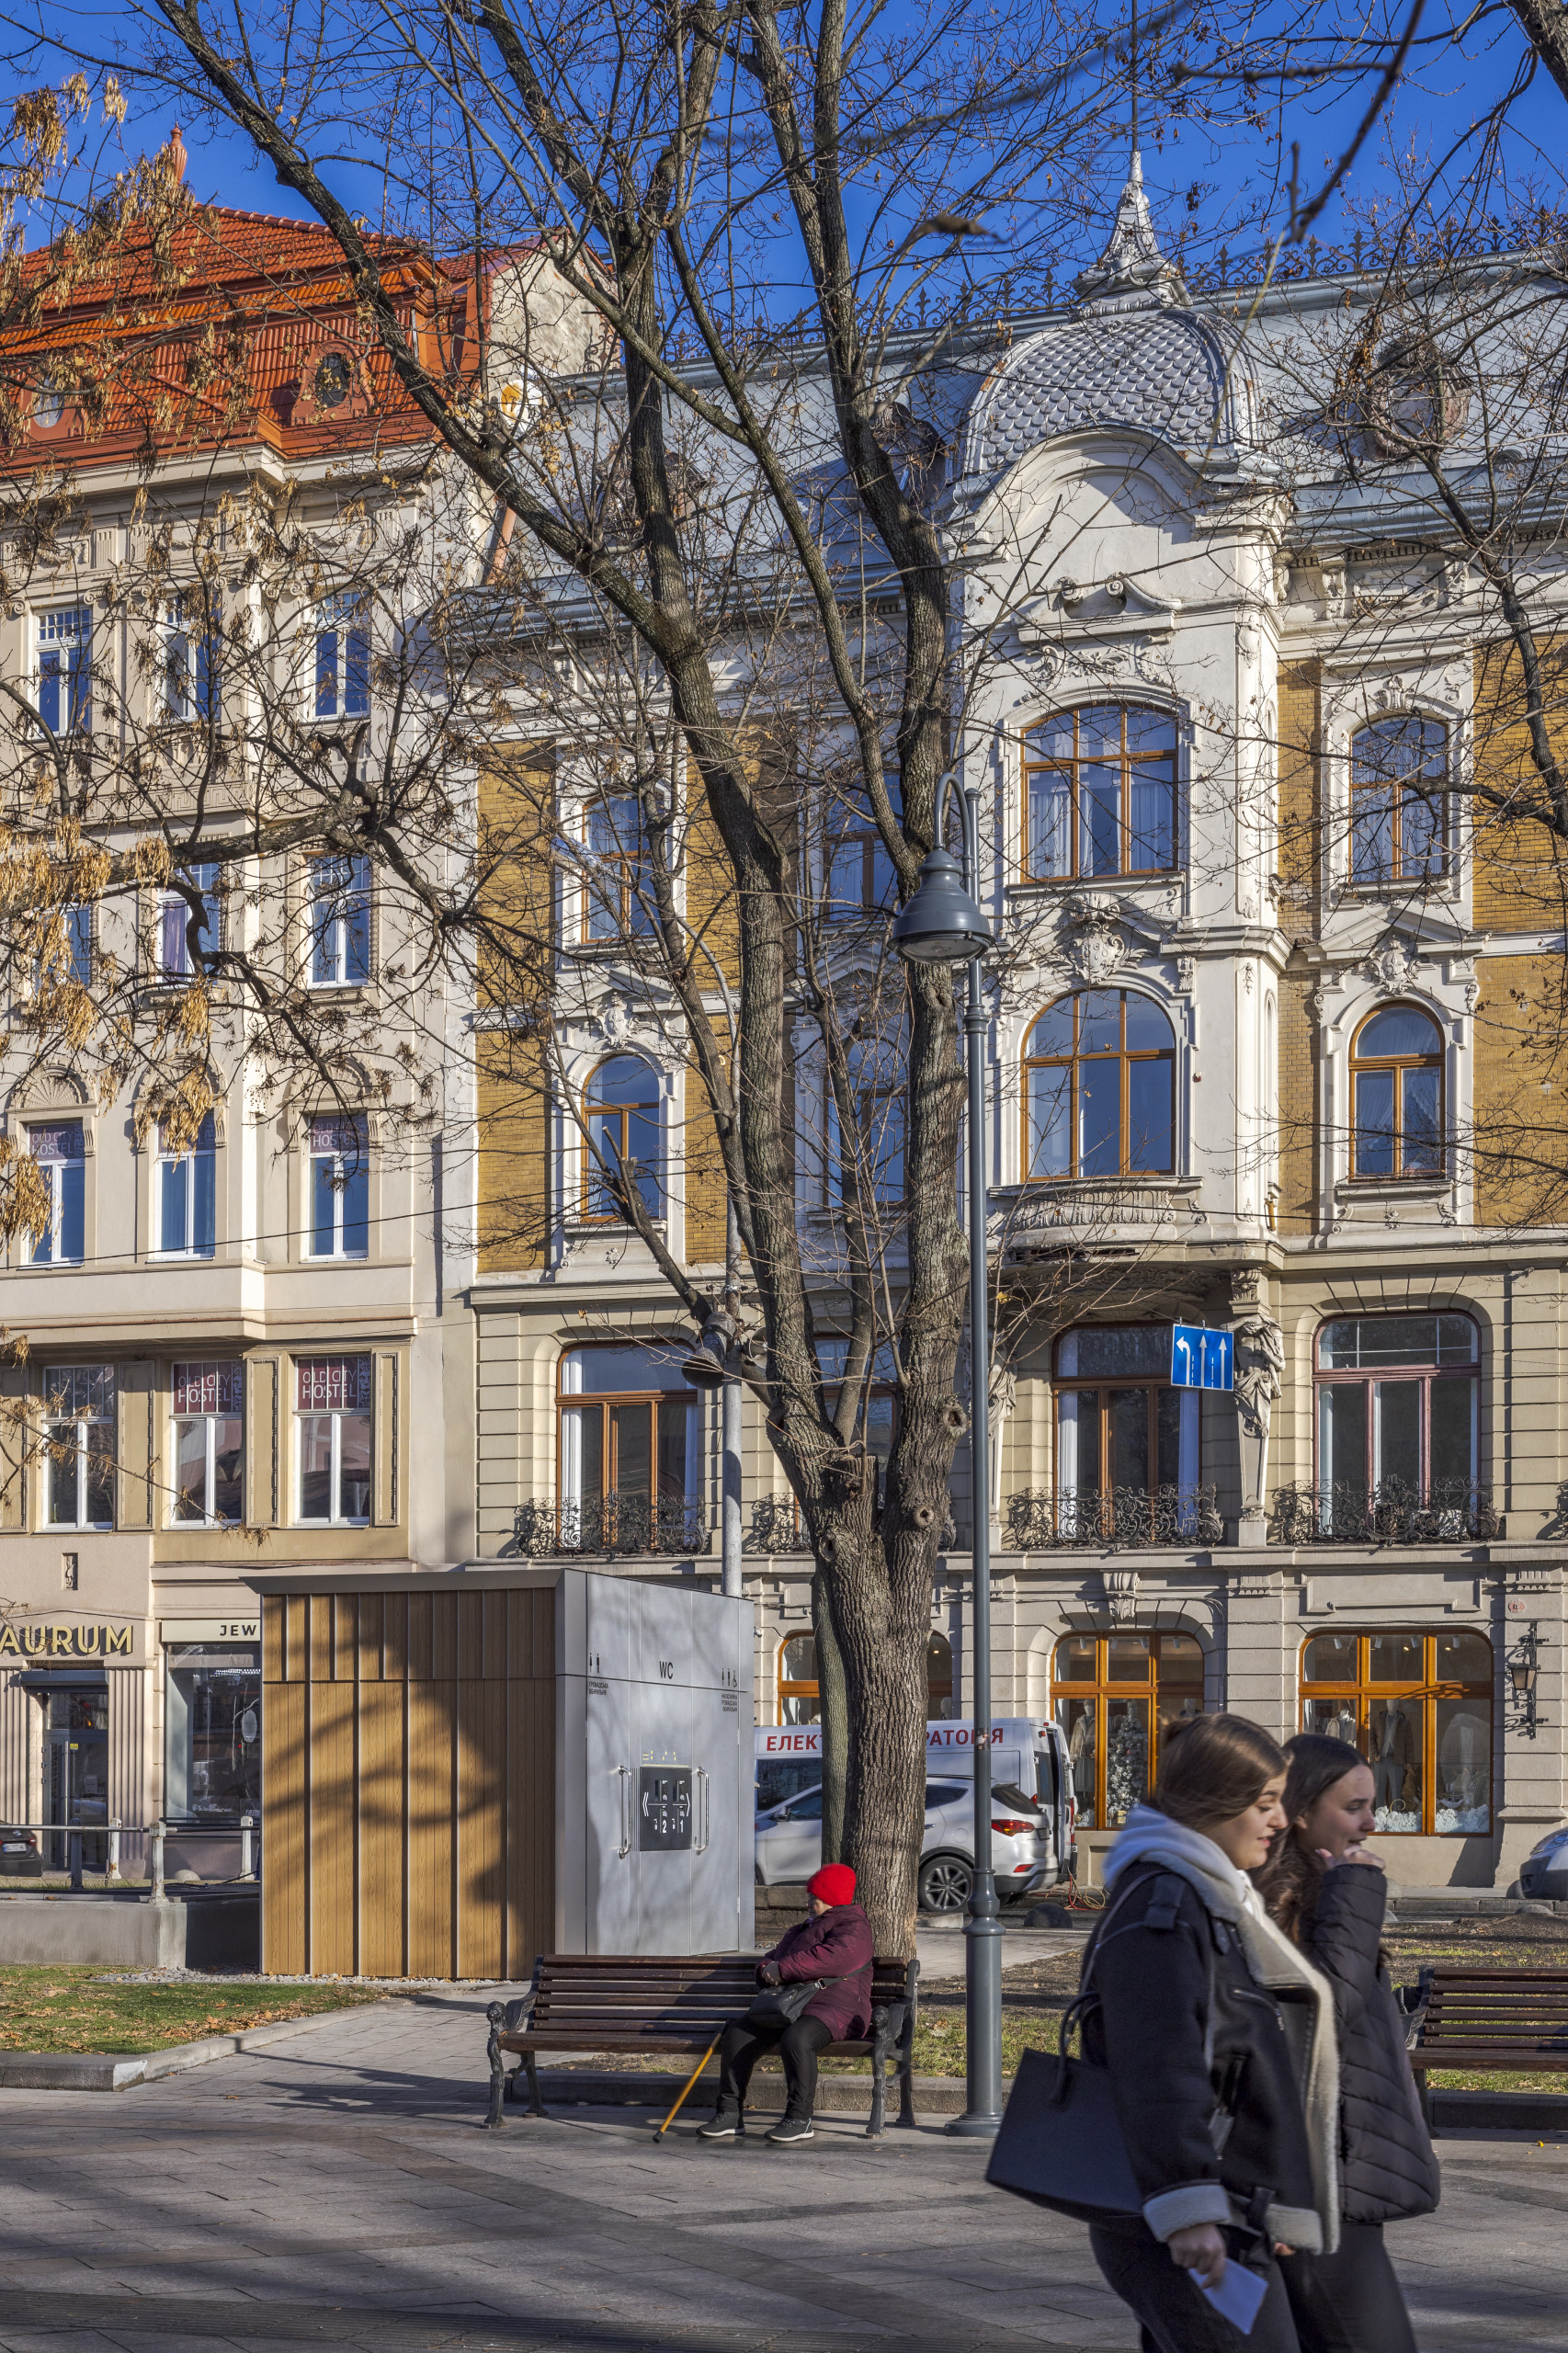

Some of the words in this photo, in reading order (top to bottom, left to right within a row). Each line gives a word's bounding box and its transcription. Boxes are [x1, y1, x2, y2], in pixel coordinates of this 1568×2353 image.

[31, 1132, 51, 1143] OLD
[31, 1142, 74, 1156] HOSTEL
[178, 1375, 202, 1388] OLD
[206, 1374, 231, 1387] CITY
[302, 1370, 328, 1384] OLD
[332, 1370, 357, 1382] CITY
[177, 1387, 232, 1404] HOSTEL
[301, 1382, 358, 1400] HOSTEL
[0, 1624, 133, 1654] AURUM
[659, 1660, 674, 1680] WC
[662, 1819, 667, 1834] 2
